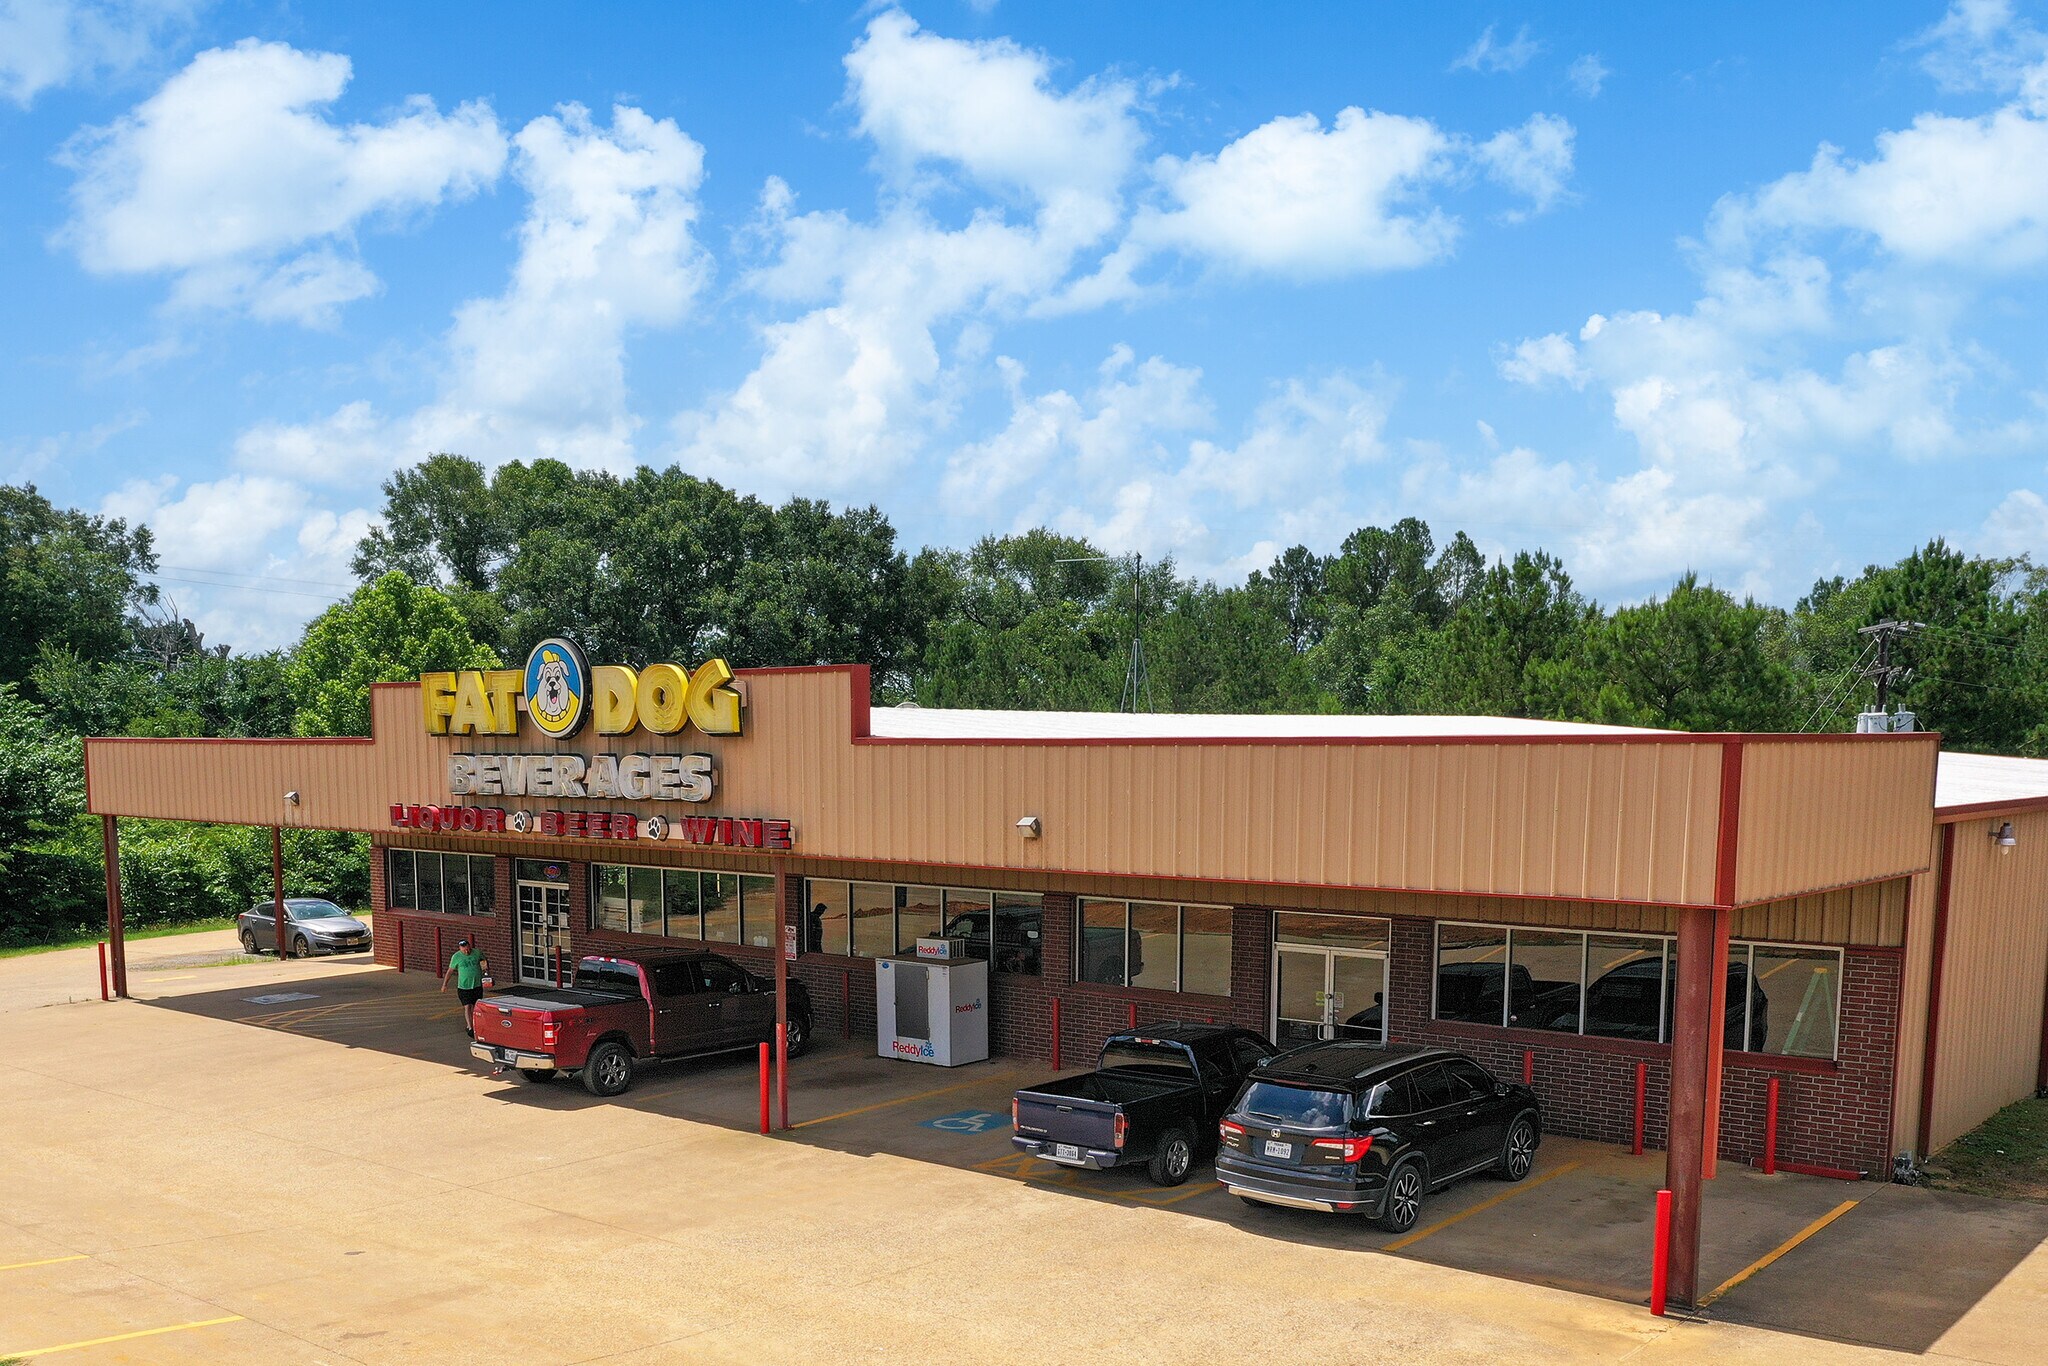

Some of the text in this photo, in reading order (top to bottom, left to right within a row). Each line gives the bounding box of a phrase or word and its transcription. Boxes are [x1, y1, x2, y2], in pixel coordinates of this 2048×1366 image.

[420, 657, 742, 736] FAT DOG
[448, 753, 713, 803] BEVERAGES
[390, 804, 791, 849] LIQUOR BEER WINE
